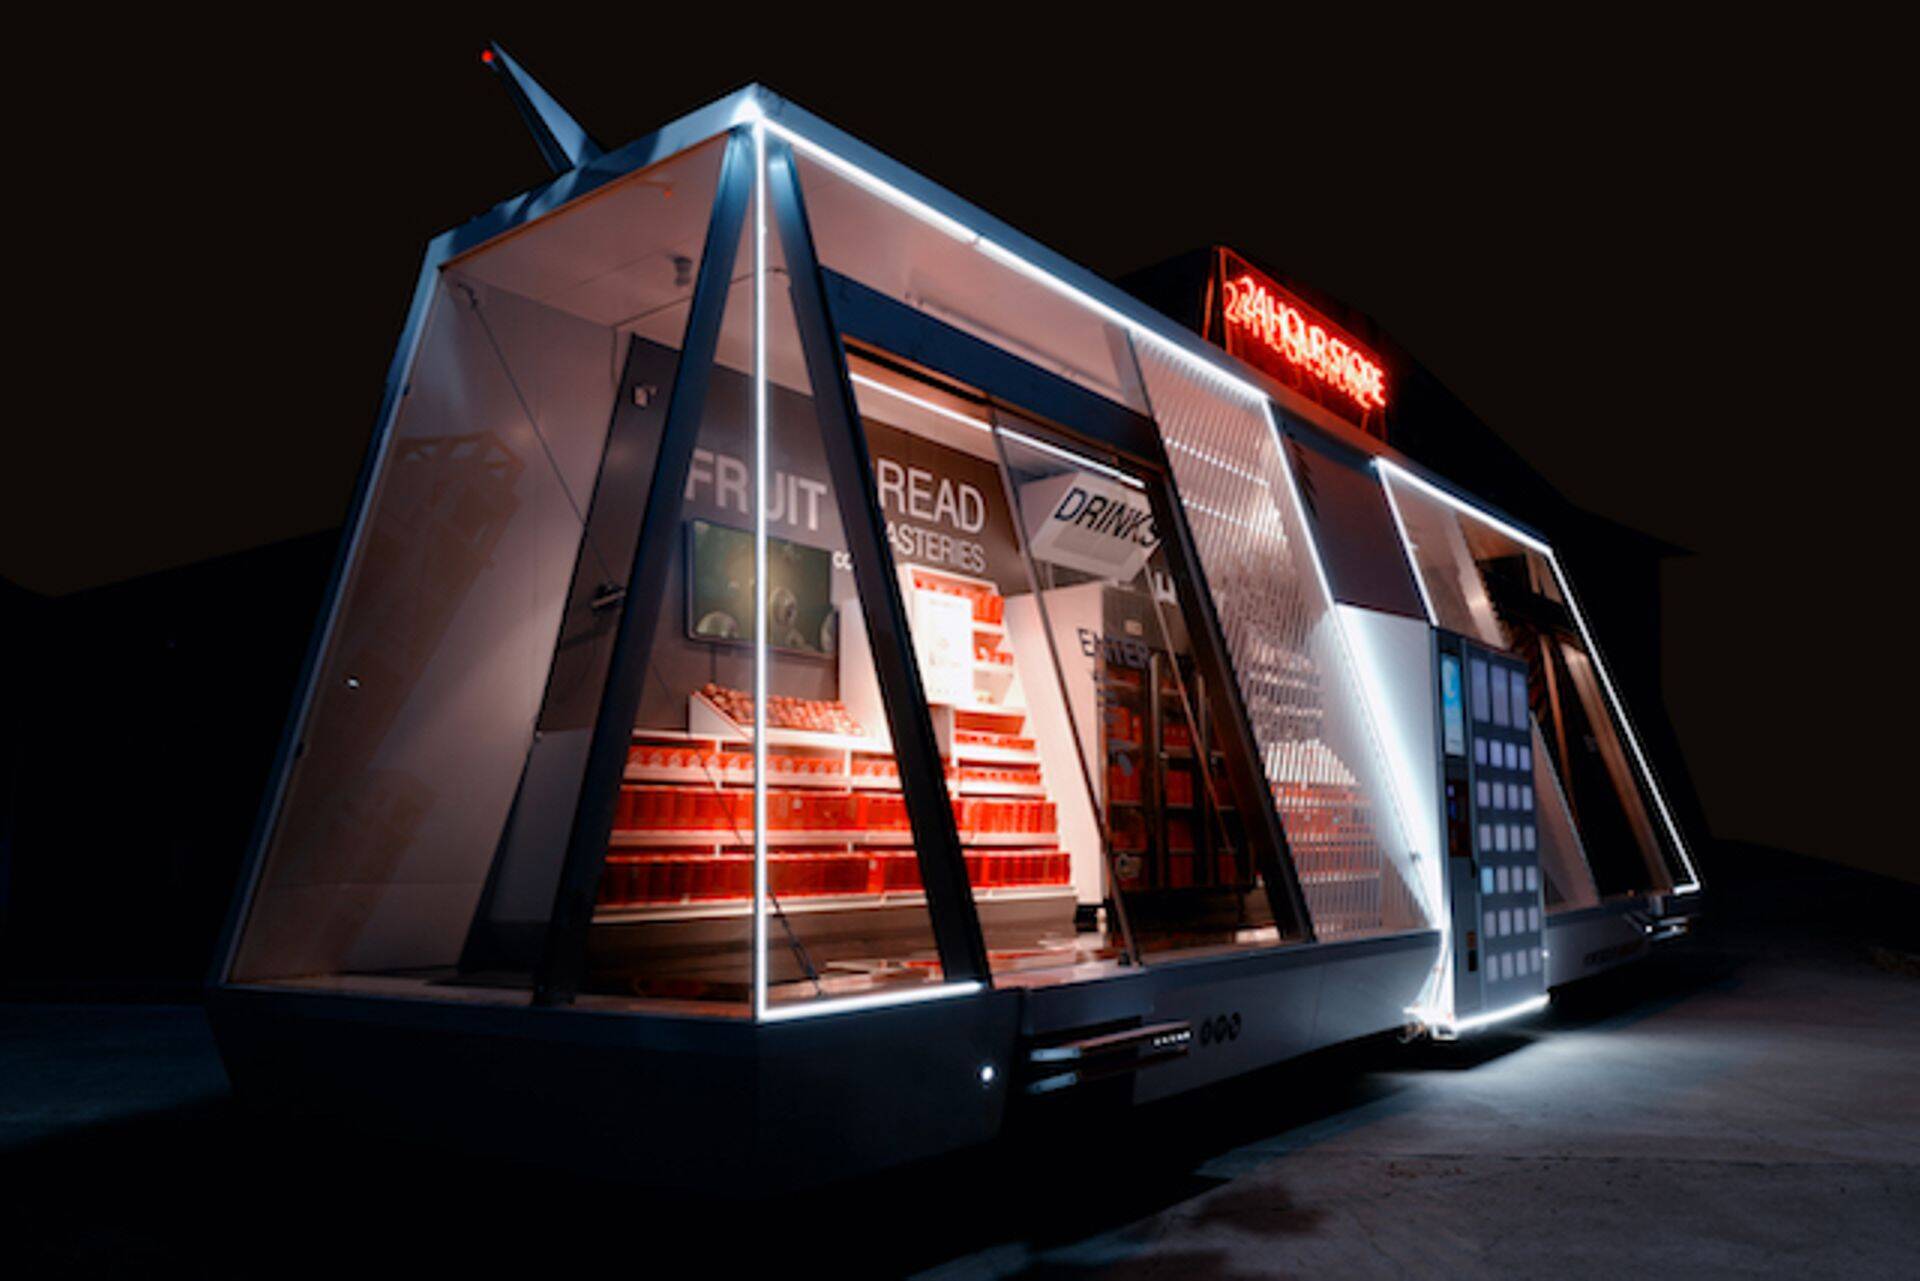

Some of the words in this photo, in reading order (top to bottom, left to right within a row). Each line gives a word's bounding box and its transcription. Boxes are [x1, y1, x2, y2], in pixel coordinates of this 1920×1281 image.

[1265, 294, 1327, 364] HOUR
[1328, 337, 1387, 407] STORE
[685, 448, 828, 532] FRUIT
[877, 457, 984, 534] READ
[1054, 486, 1158, 549] DRINKS
[886, 520, 986, 573] ASTERIES
